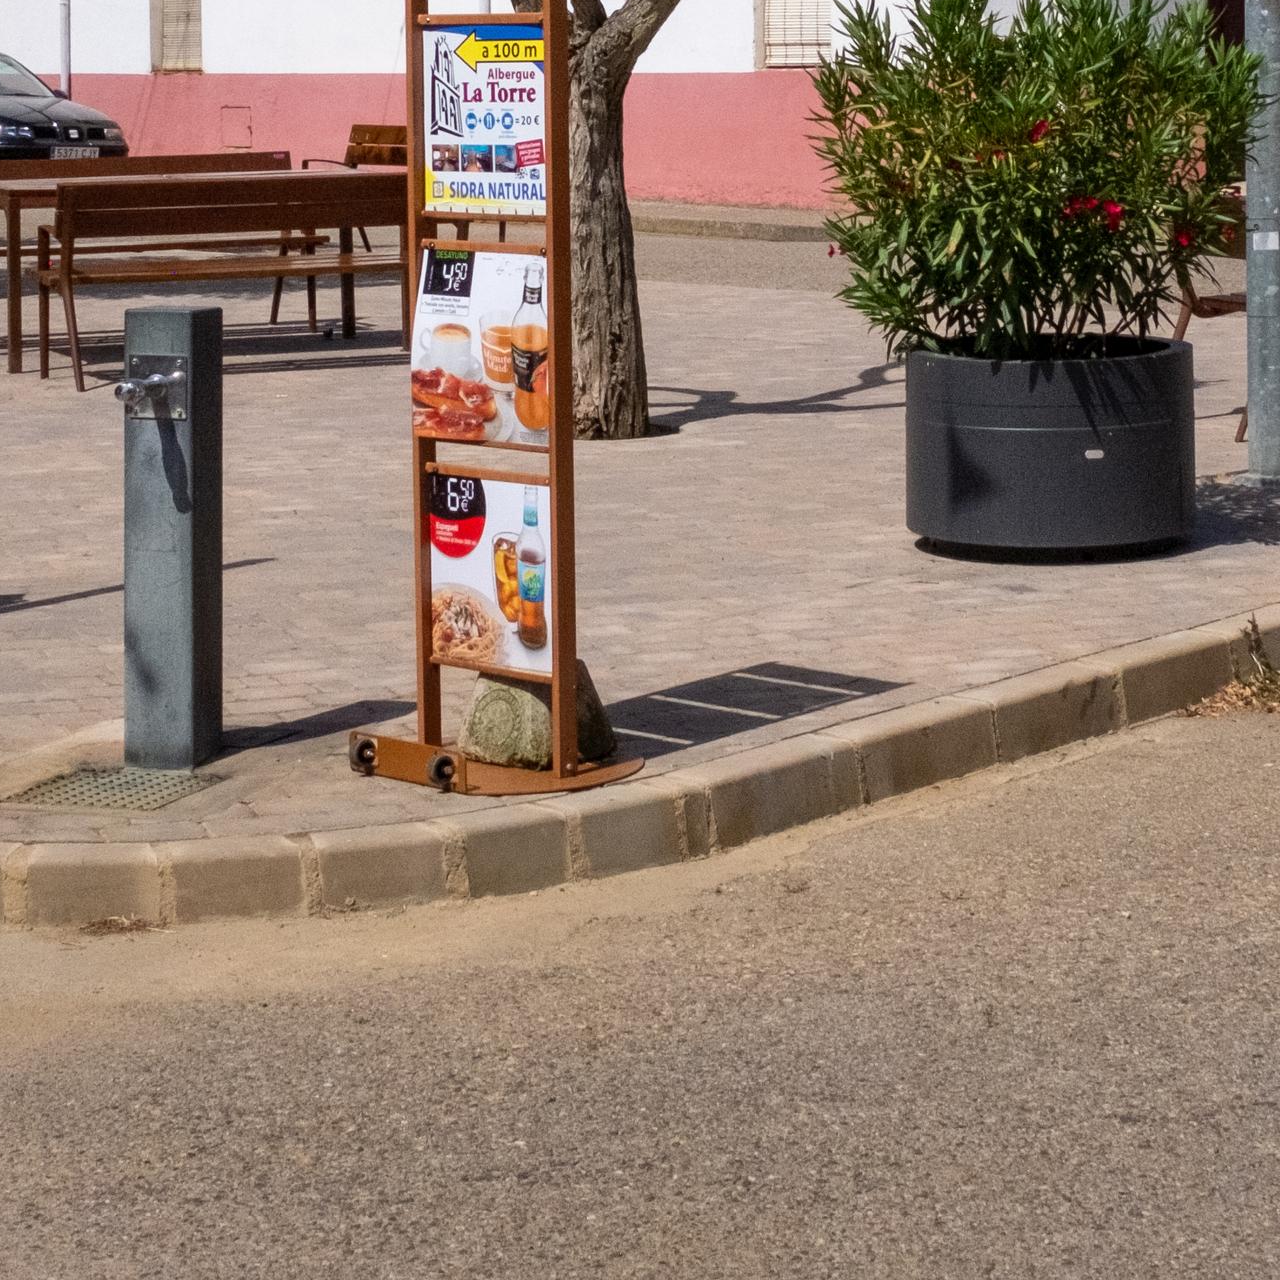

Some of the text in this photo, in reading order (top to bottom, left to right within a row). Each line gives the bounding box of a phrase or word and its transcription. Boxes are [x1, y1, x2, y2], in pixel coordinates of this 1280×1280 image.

[482, 42, 537, 58] a 100 m
[487, 68, 536, 82] Albergue
[462, 81, 536, 103] La Torre
[521, 116, 532, 125] 20
[449, 181, 546, 200] SIDRA NATURAL
[436, 250, 469, 260] DESAYUNO
